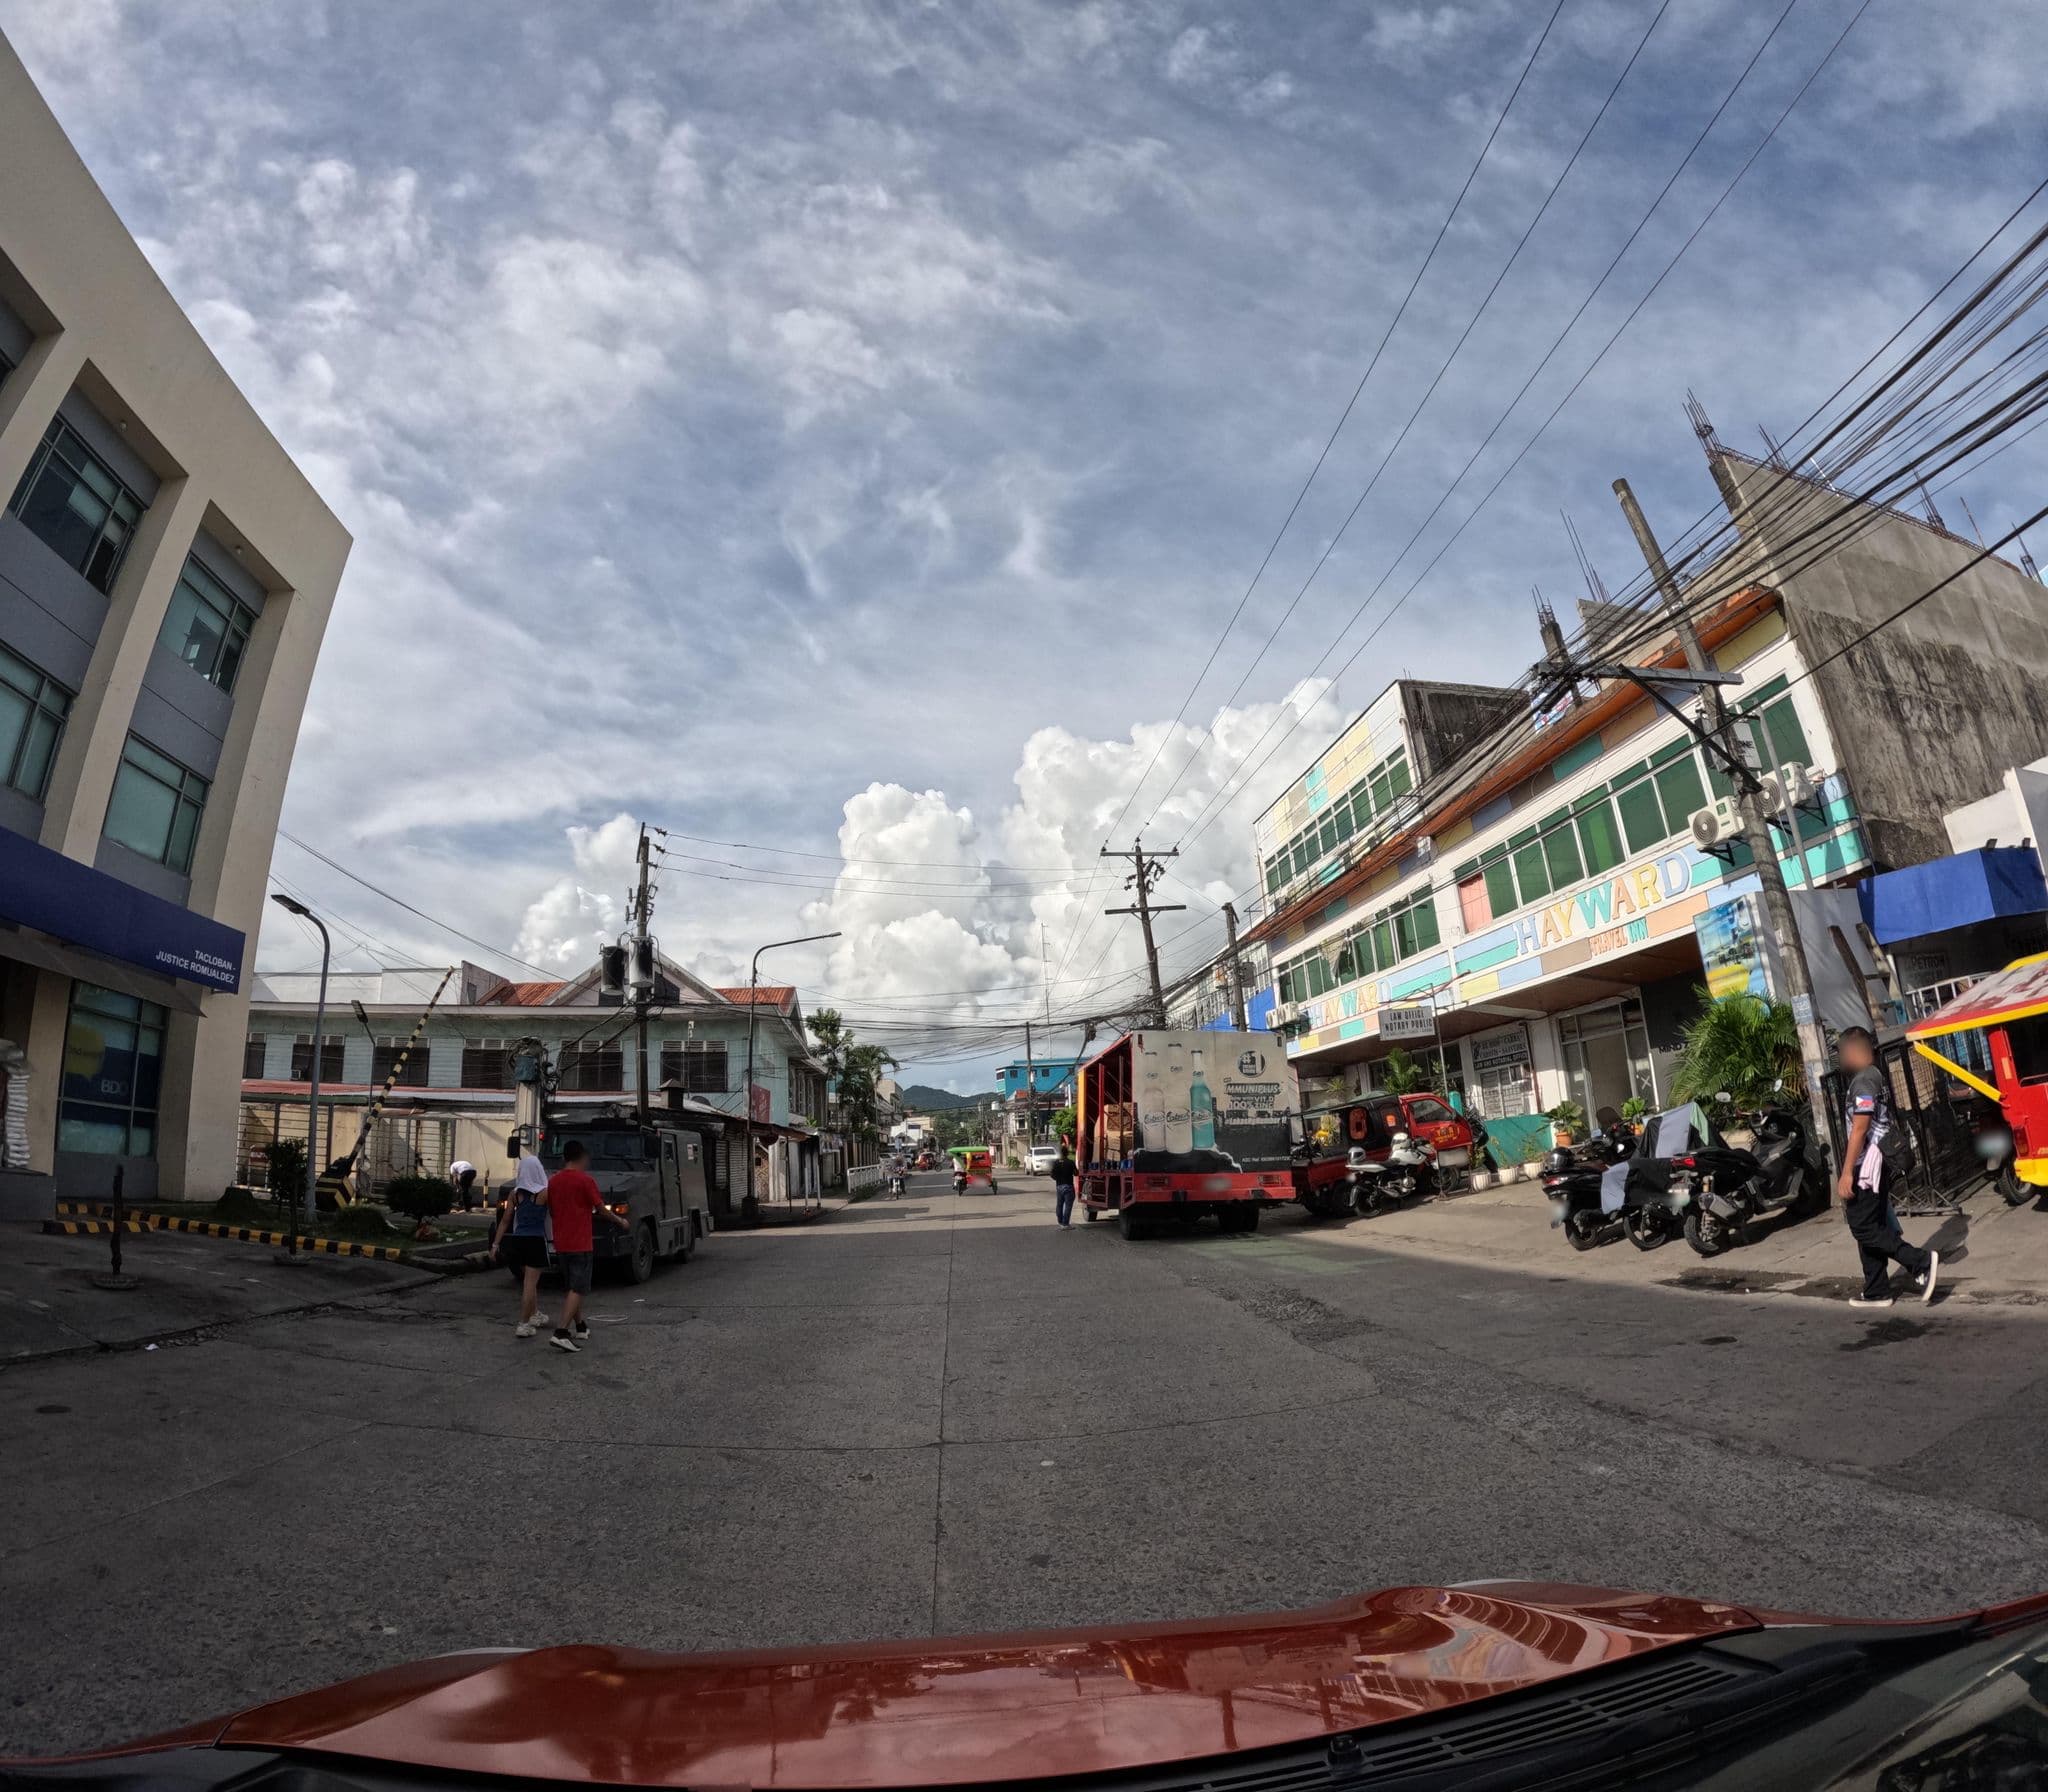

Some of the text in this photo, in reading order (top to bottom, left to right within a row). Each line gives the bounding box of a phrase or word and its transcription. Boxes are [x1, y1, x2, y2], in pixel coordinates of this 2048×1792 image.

[1513, 852, 1690, 956] HAYWARD
[1589, 917, 1649, 956] TRAVEL INN
[156, 951, 235, 984] JUSTICE ROMUALDEZ
[195, 950, 232, 970] TACLOBAN
[1308, 977, 1392, 1030] HAYWARD
[1390, 1010, 1424, 1021] LAW OFFICE
[1385, 1018, 1432, 1031] NOTARY PUBLIC
